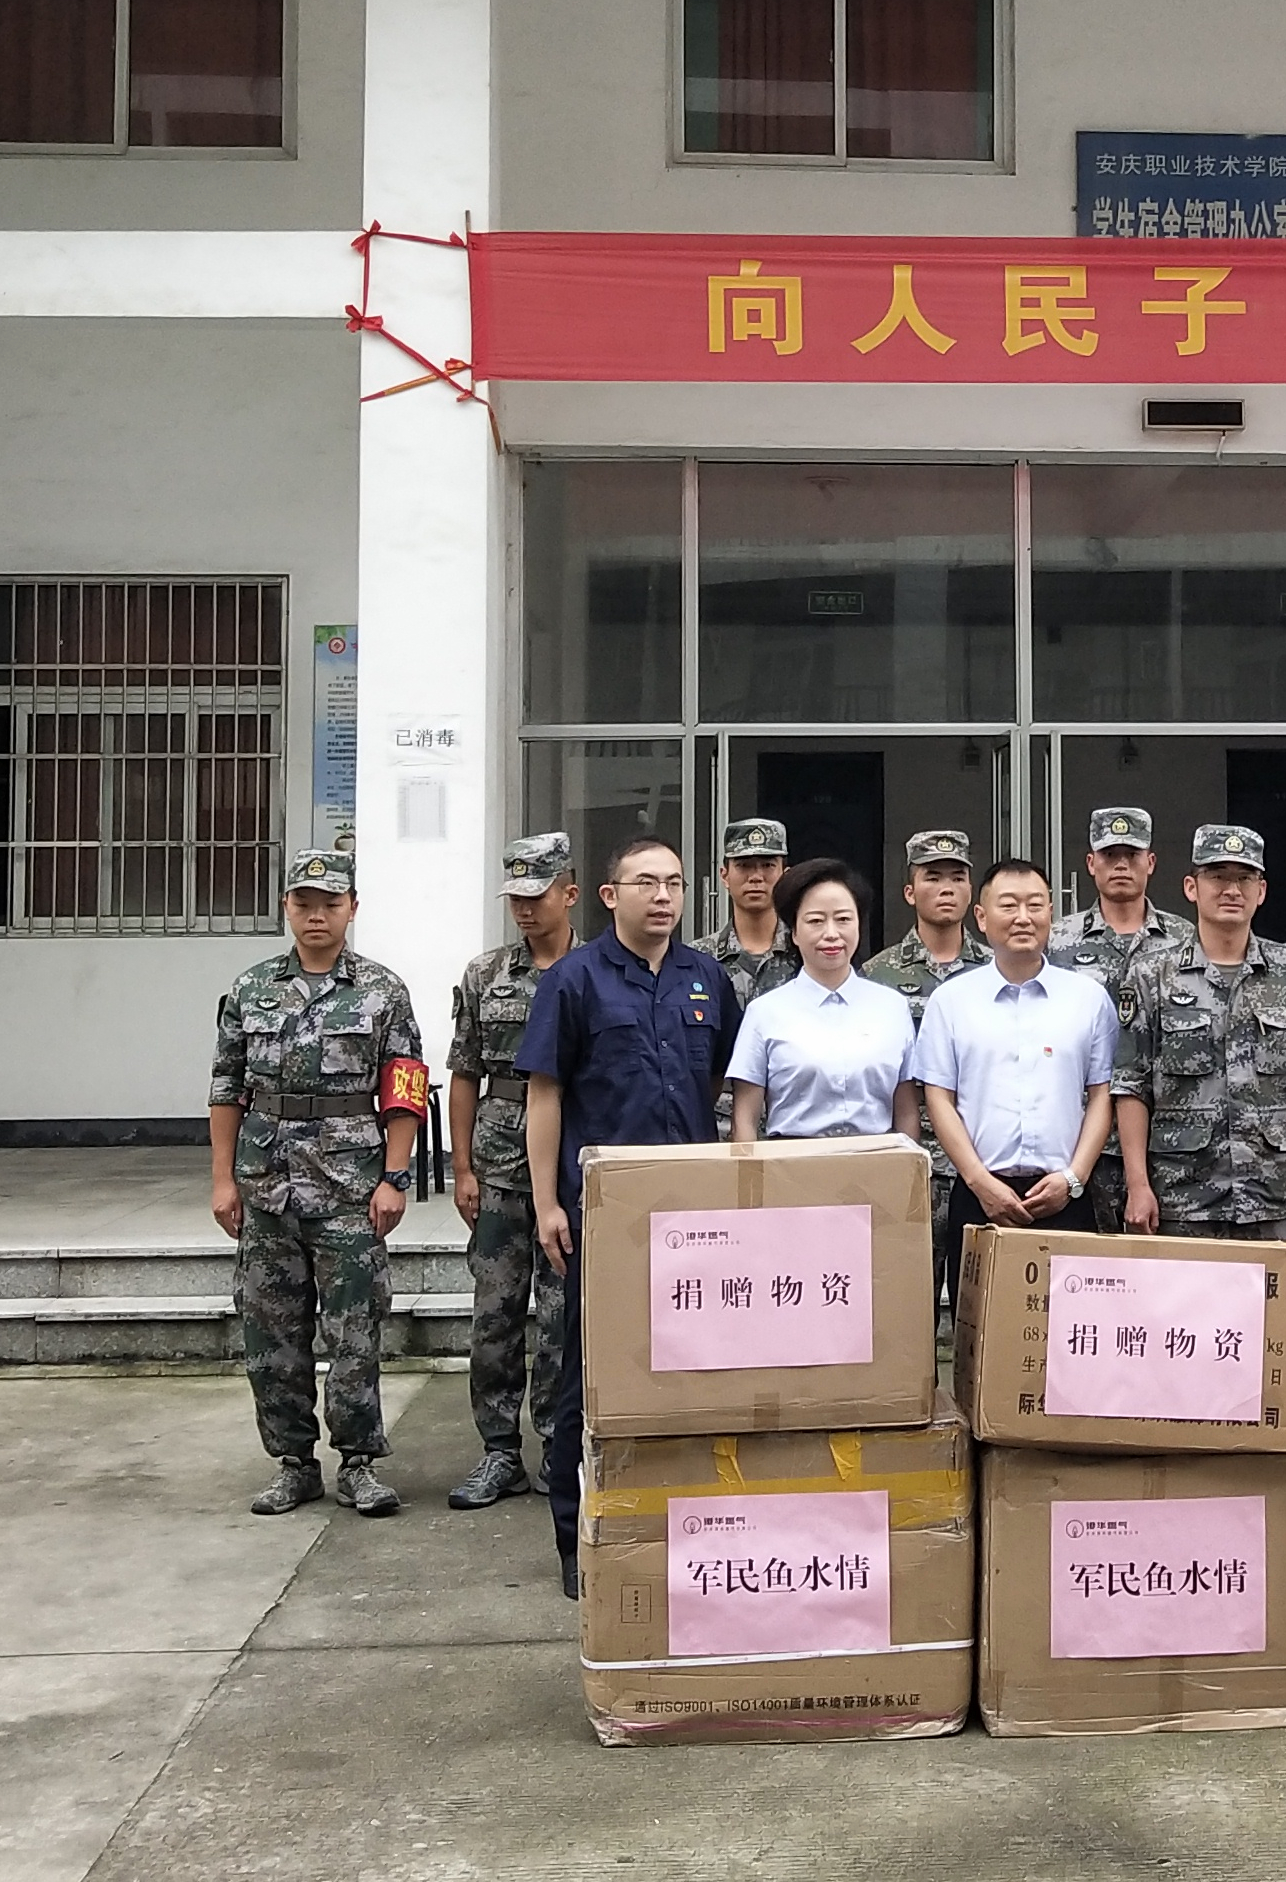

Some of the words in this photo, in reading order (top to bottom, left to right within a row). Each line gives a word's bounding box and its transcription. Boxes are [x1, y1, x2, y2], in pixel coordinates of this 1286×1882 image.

[395, 728, 456, 748] 已消毒
[393, 1066, 429, 1106] 攻坚
[671, 1272, 851, 1311] 捐赠物资
[1067, 1323, 1244, 1363] 捐赠物资
[1266, 1337, 1284, 1357] kg
[687, 1554, 871, 1596] 军民鱼水情
[1069, 1558, 1248, 1598] 军民鱼水情
